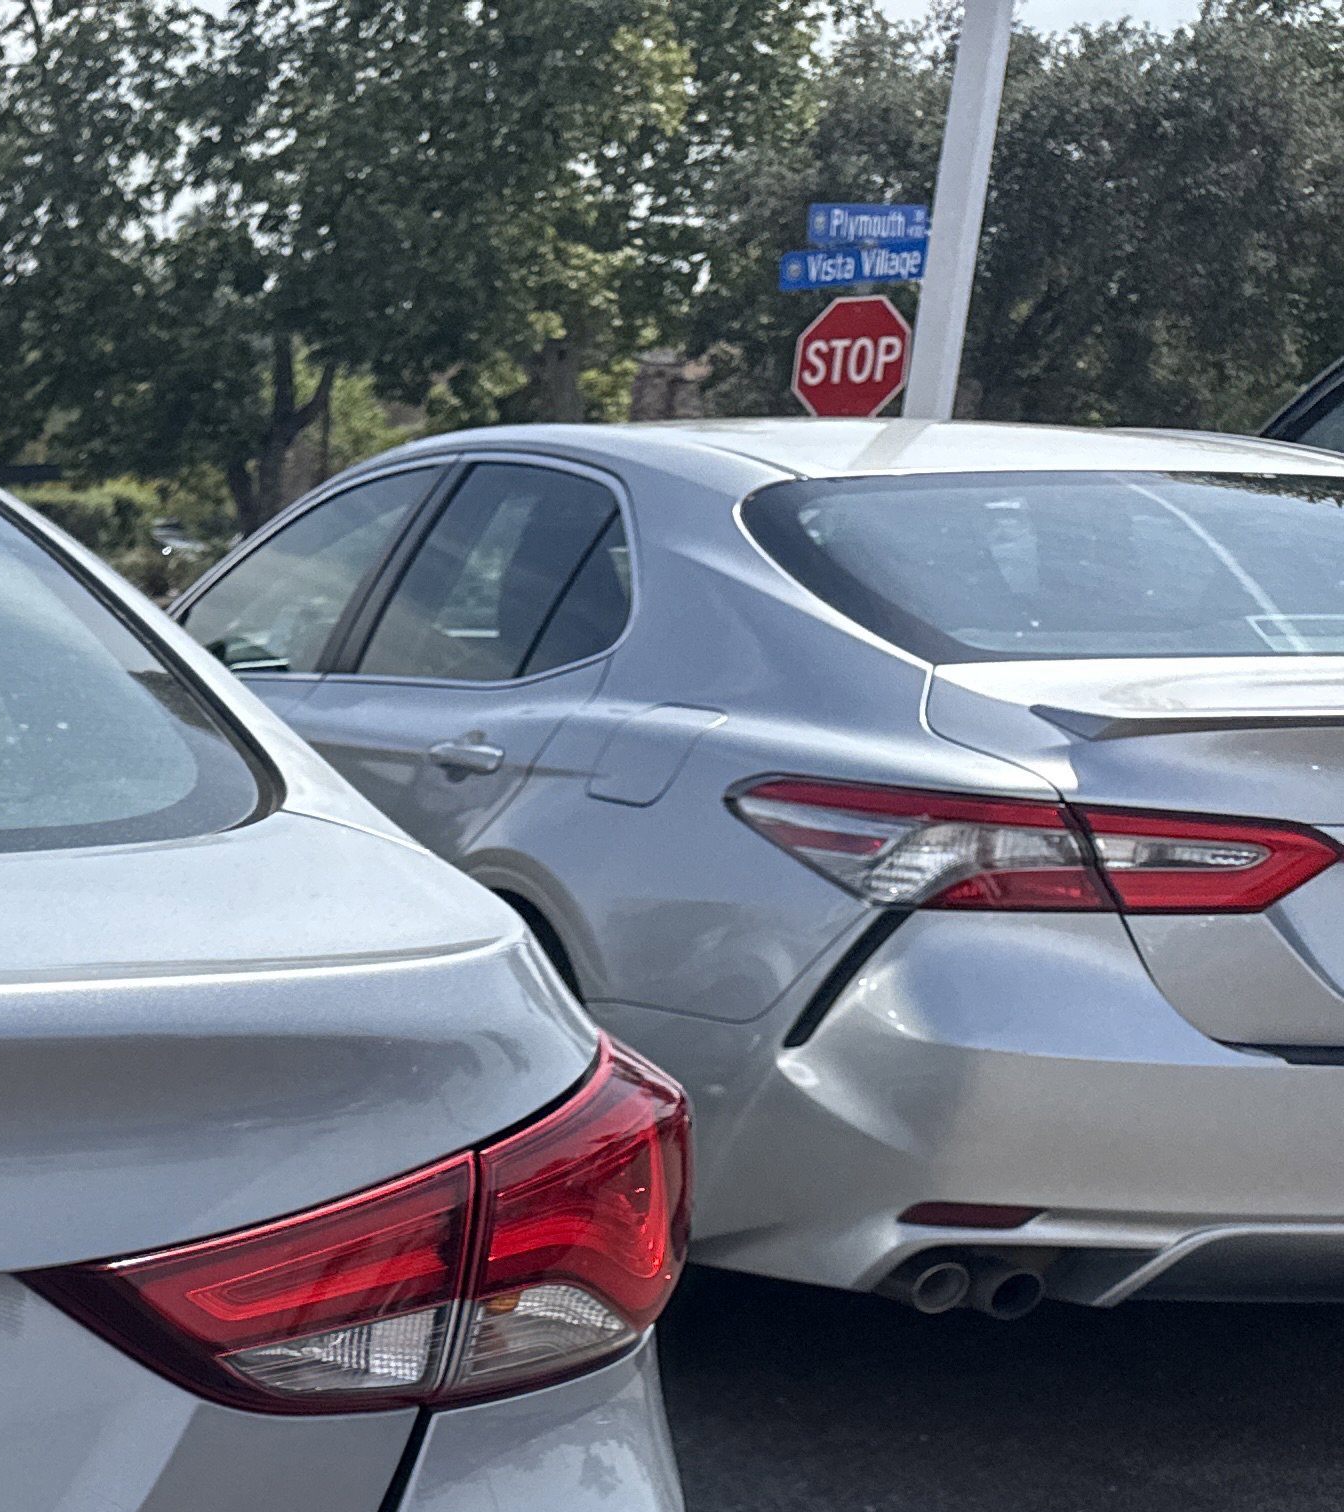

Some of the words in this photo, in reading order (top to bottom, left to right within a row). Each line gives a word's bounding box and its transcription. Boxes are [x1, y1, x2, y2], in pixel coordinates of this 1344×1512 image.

[829, 208, 907, 241] Plymouth
[806, 253, 855, 282] Vista
[860, 248, 921, 280] Village
[801, 335, 903, 386] STOP
